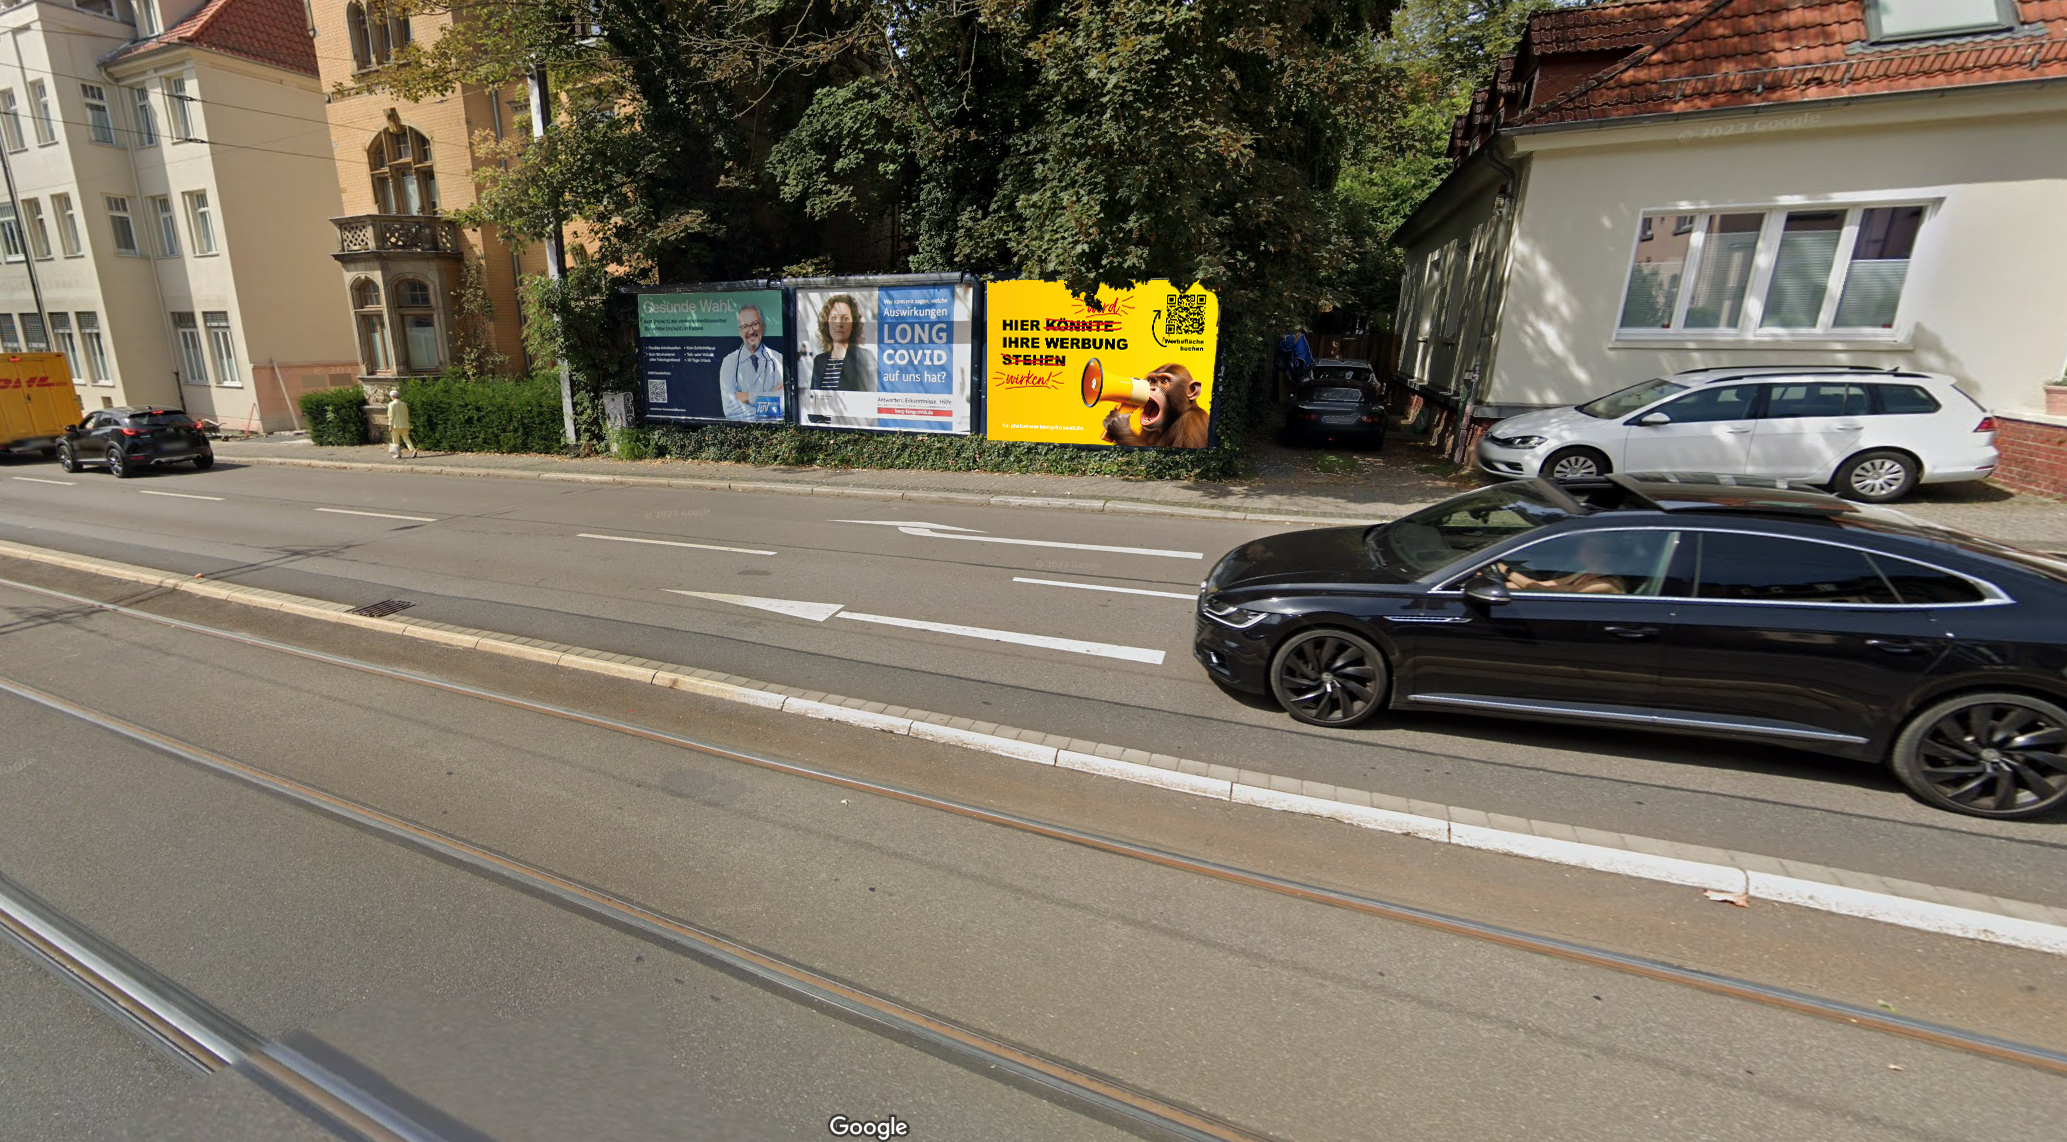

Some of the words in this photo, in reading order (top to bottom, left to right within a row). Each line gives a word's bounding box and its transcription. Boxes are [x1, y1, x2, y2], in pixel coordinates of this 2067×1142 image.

[643, 299, 697, 313] Gesunde
[883, 306, 948, 318] Auswirkungen
[1002, 319, 1041, 331] HIER
[1045, 317, 1115, 332] KÖNNTE
[883, 323, 947, 344] LONG
[1002, 337, 1040, 348] IHRE
[1045, 337, 1128, 350] WERBUNG
[883, 349, 947, 366] COVID
[1002, 354, 1066, 366] STEHEN
[883, 371, 900, 382] auf
[902, 374, 921, 382] uns
[924, 371, 947, 383] hat?
[1005, 370, 1053, 386] wirken!
[757, 401, 770, 413] TÜV
